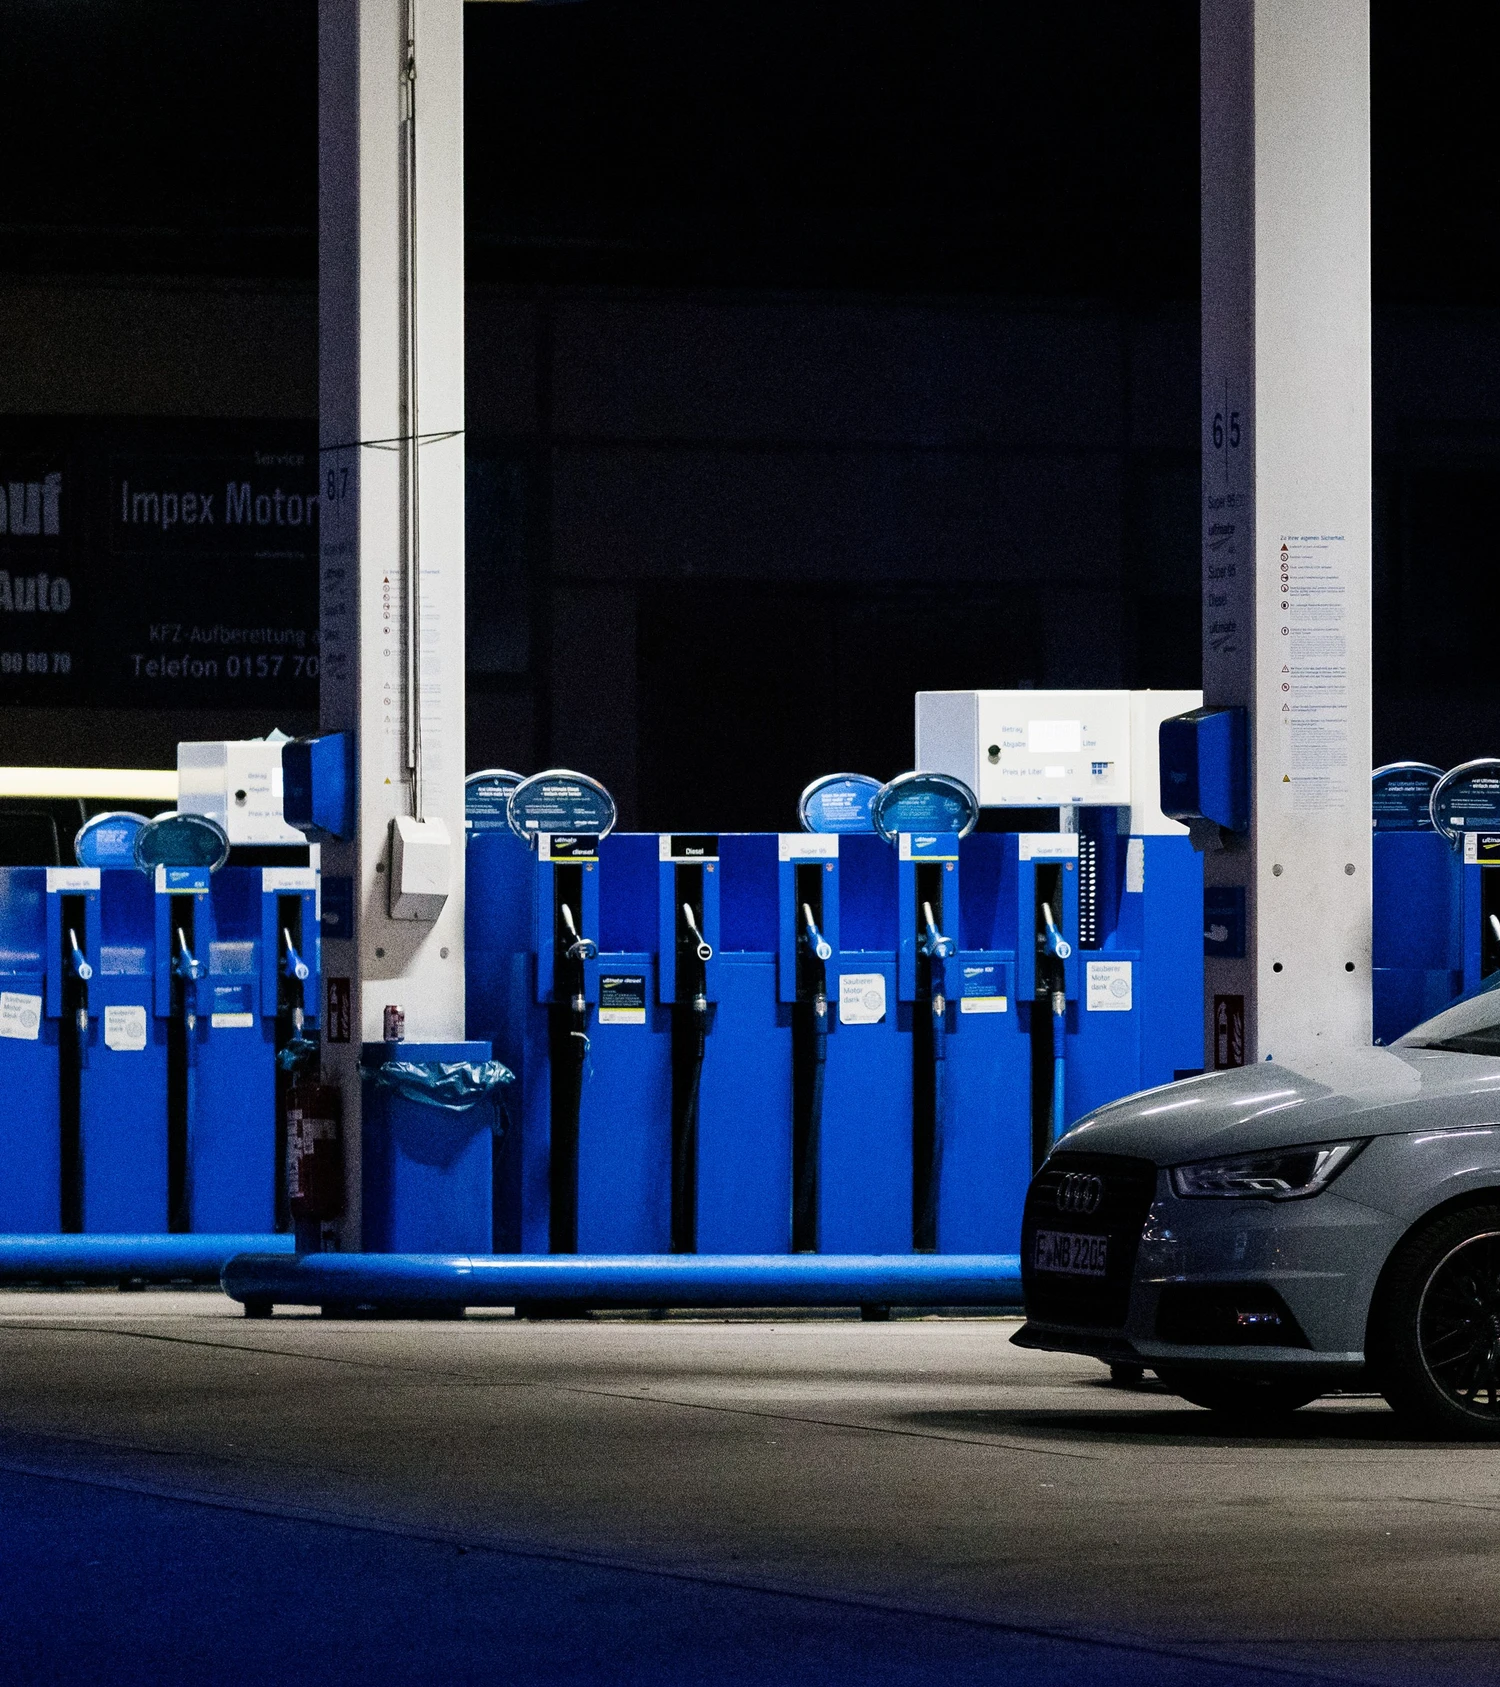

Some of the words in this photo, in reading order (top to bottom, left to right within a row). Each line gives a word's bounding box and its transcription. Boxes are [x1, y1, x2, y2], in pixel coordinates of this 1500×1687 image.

[1213, 413, 1223, 449] 6
[1230, 412, 1240, 447] 5
[327, 469, 335, 500] 8
[340, 468, 348, 499] 7
[0, 472, 62, 536] uf
[121, 480, 214, 531] Impex
[131, 653, 218, 679] Telefon
[226, 654, 285, 679] 0157
[1091, 983, 1108, 991] dank
[1036, 1234, 1046, 1265] F
[1073, 1238, 1107, 1271] 2205
